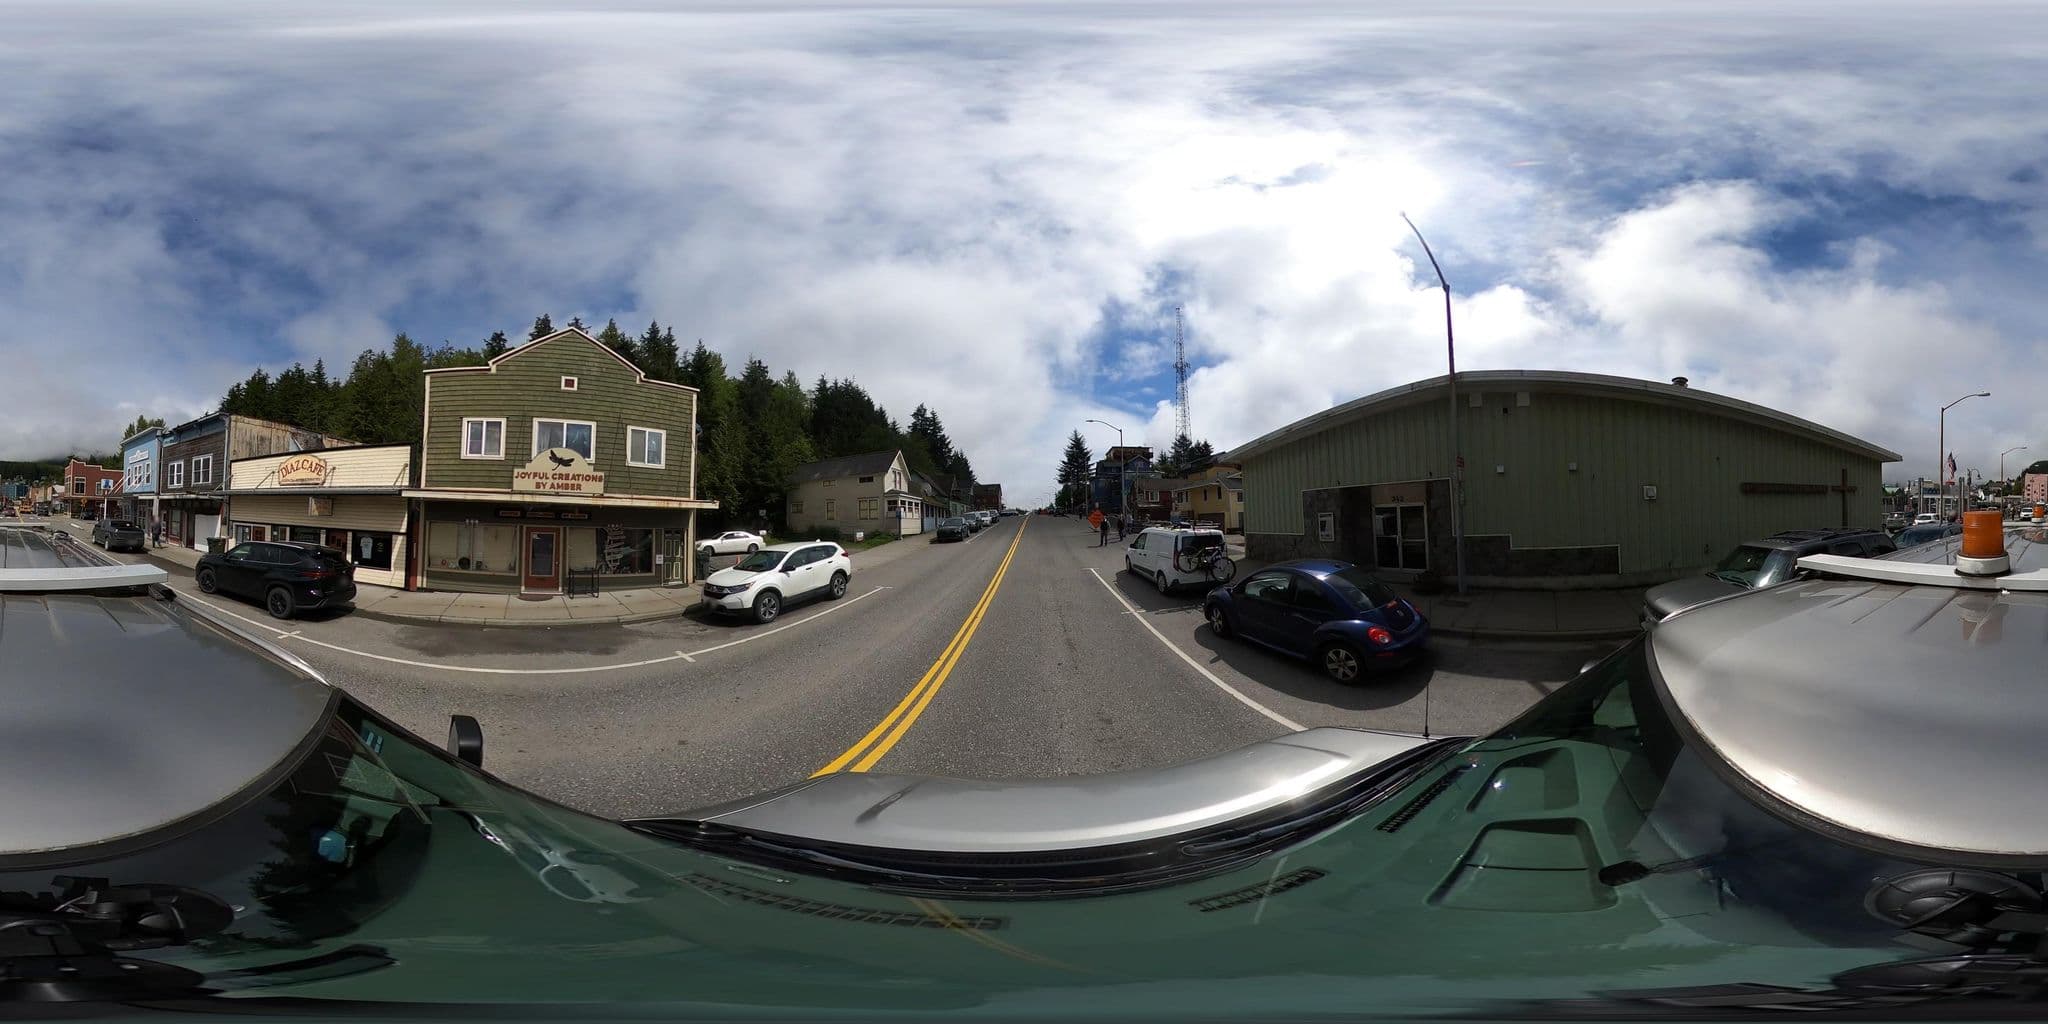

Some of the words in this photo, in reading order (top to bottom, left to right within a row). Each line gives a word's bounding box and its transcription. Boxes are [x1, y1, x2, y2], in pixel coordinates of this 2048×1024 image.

[280, 460, 301, 478] DIAZ
[301, 459, 325, 476] CAFE
[515, 472, 550, 480] JOYFUL
[551, 473, 604, 482] CREATIONS
[549, 483, 582, 491] AMBER
